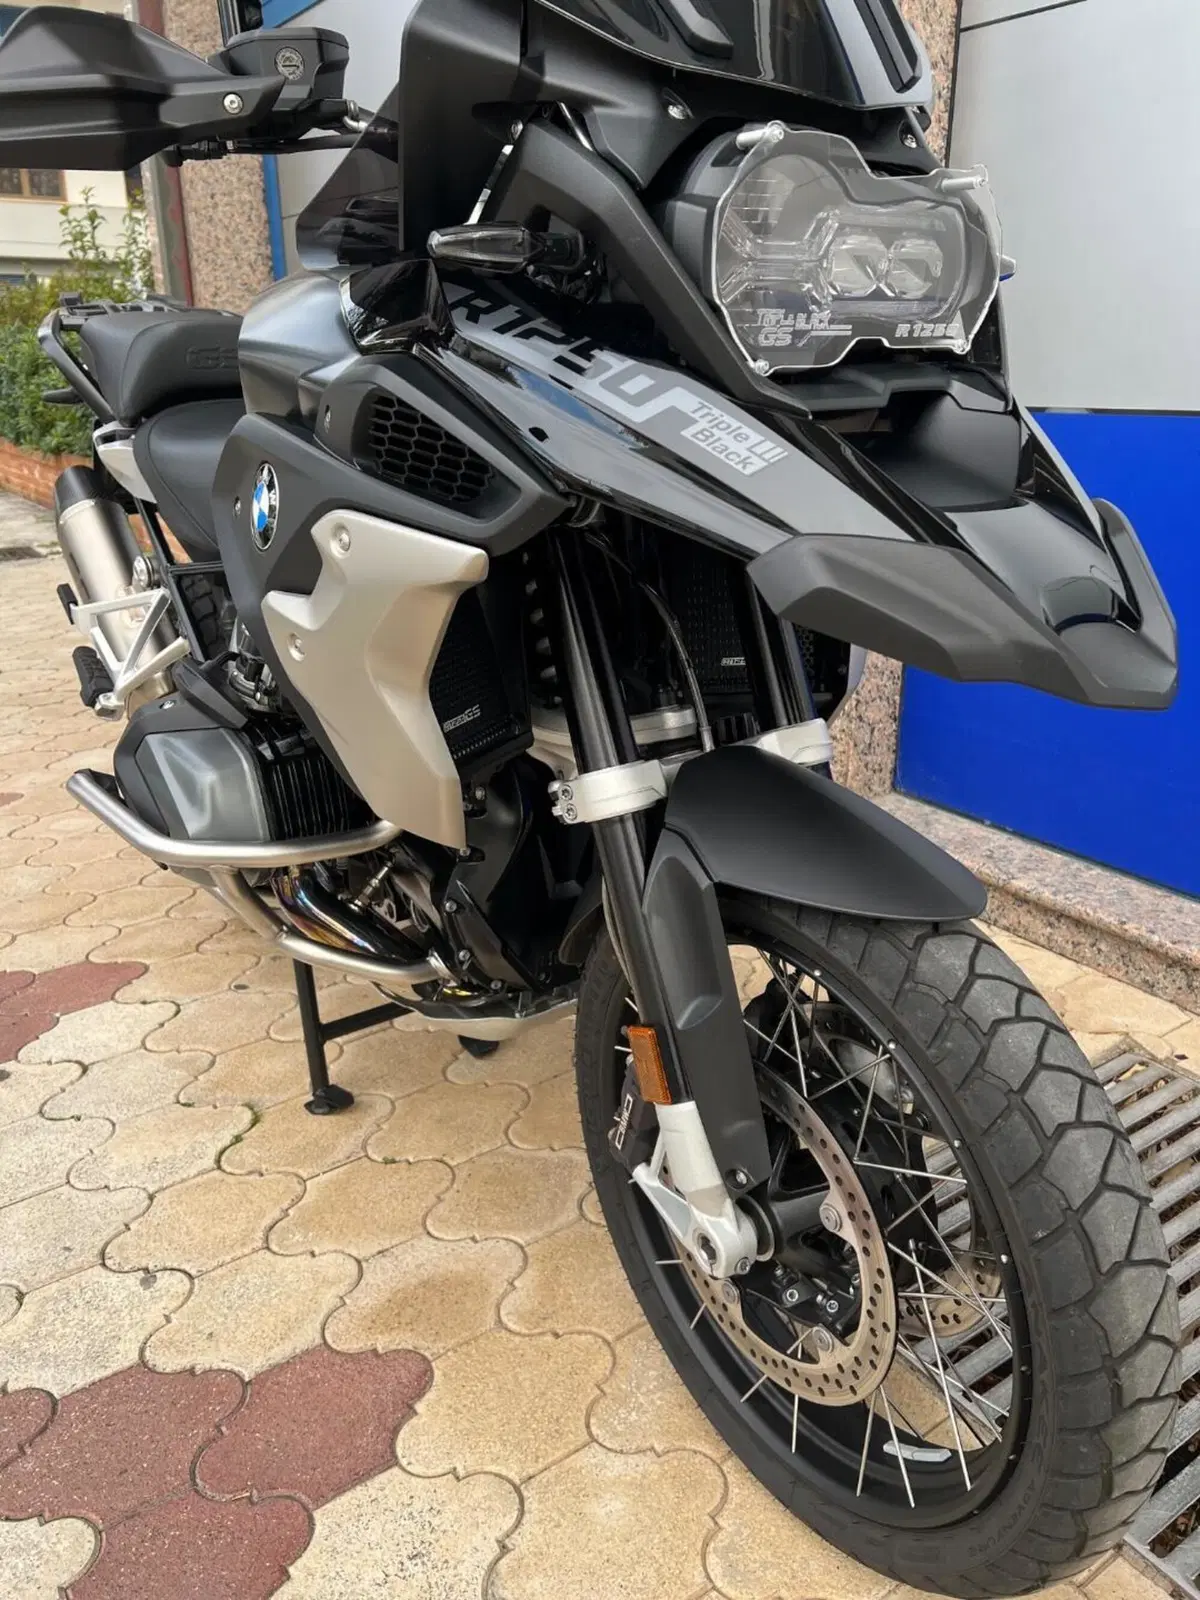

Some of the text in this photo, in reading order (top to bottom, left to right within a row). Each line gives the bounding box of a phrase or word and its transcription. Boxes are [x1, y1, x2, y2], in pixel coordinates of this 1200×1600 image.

[758, 327, 793, 346] GS
[690, 401, 751, 443] Triple
[690, 427, 755, 471] Black
